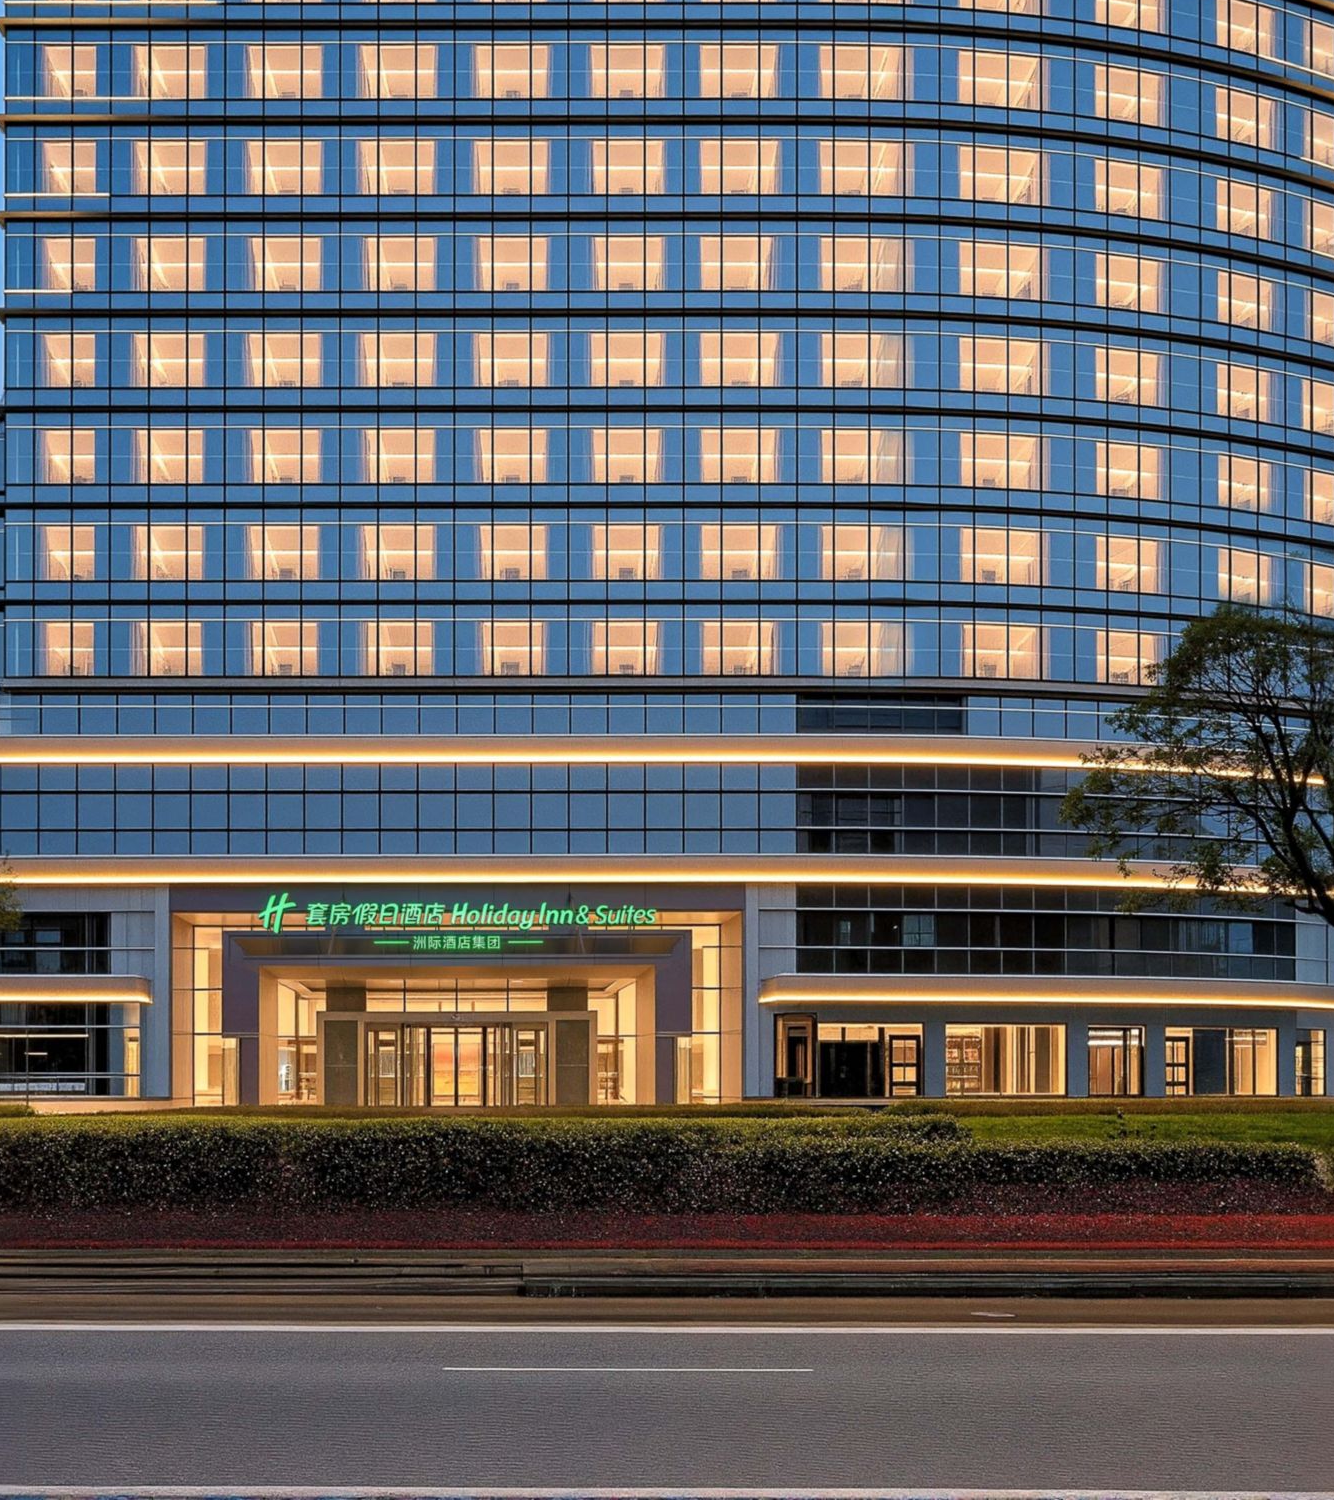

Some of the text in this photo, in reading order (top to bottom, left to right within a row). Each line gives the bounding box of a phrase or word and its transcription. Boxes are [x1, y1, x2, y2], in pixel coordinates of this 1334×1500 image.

[306, 902, 445, 926] 套房假日酒店
[451, 902, 657, 931] Holiday Inn & Suites
[412, 935, 502, 950] 洲际酒店集团
